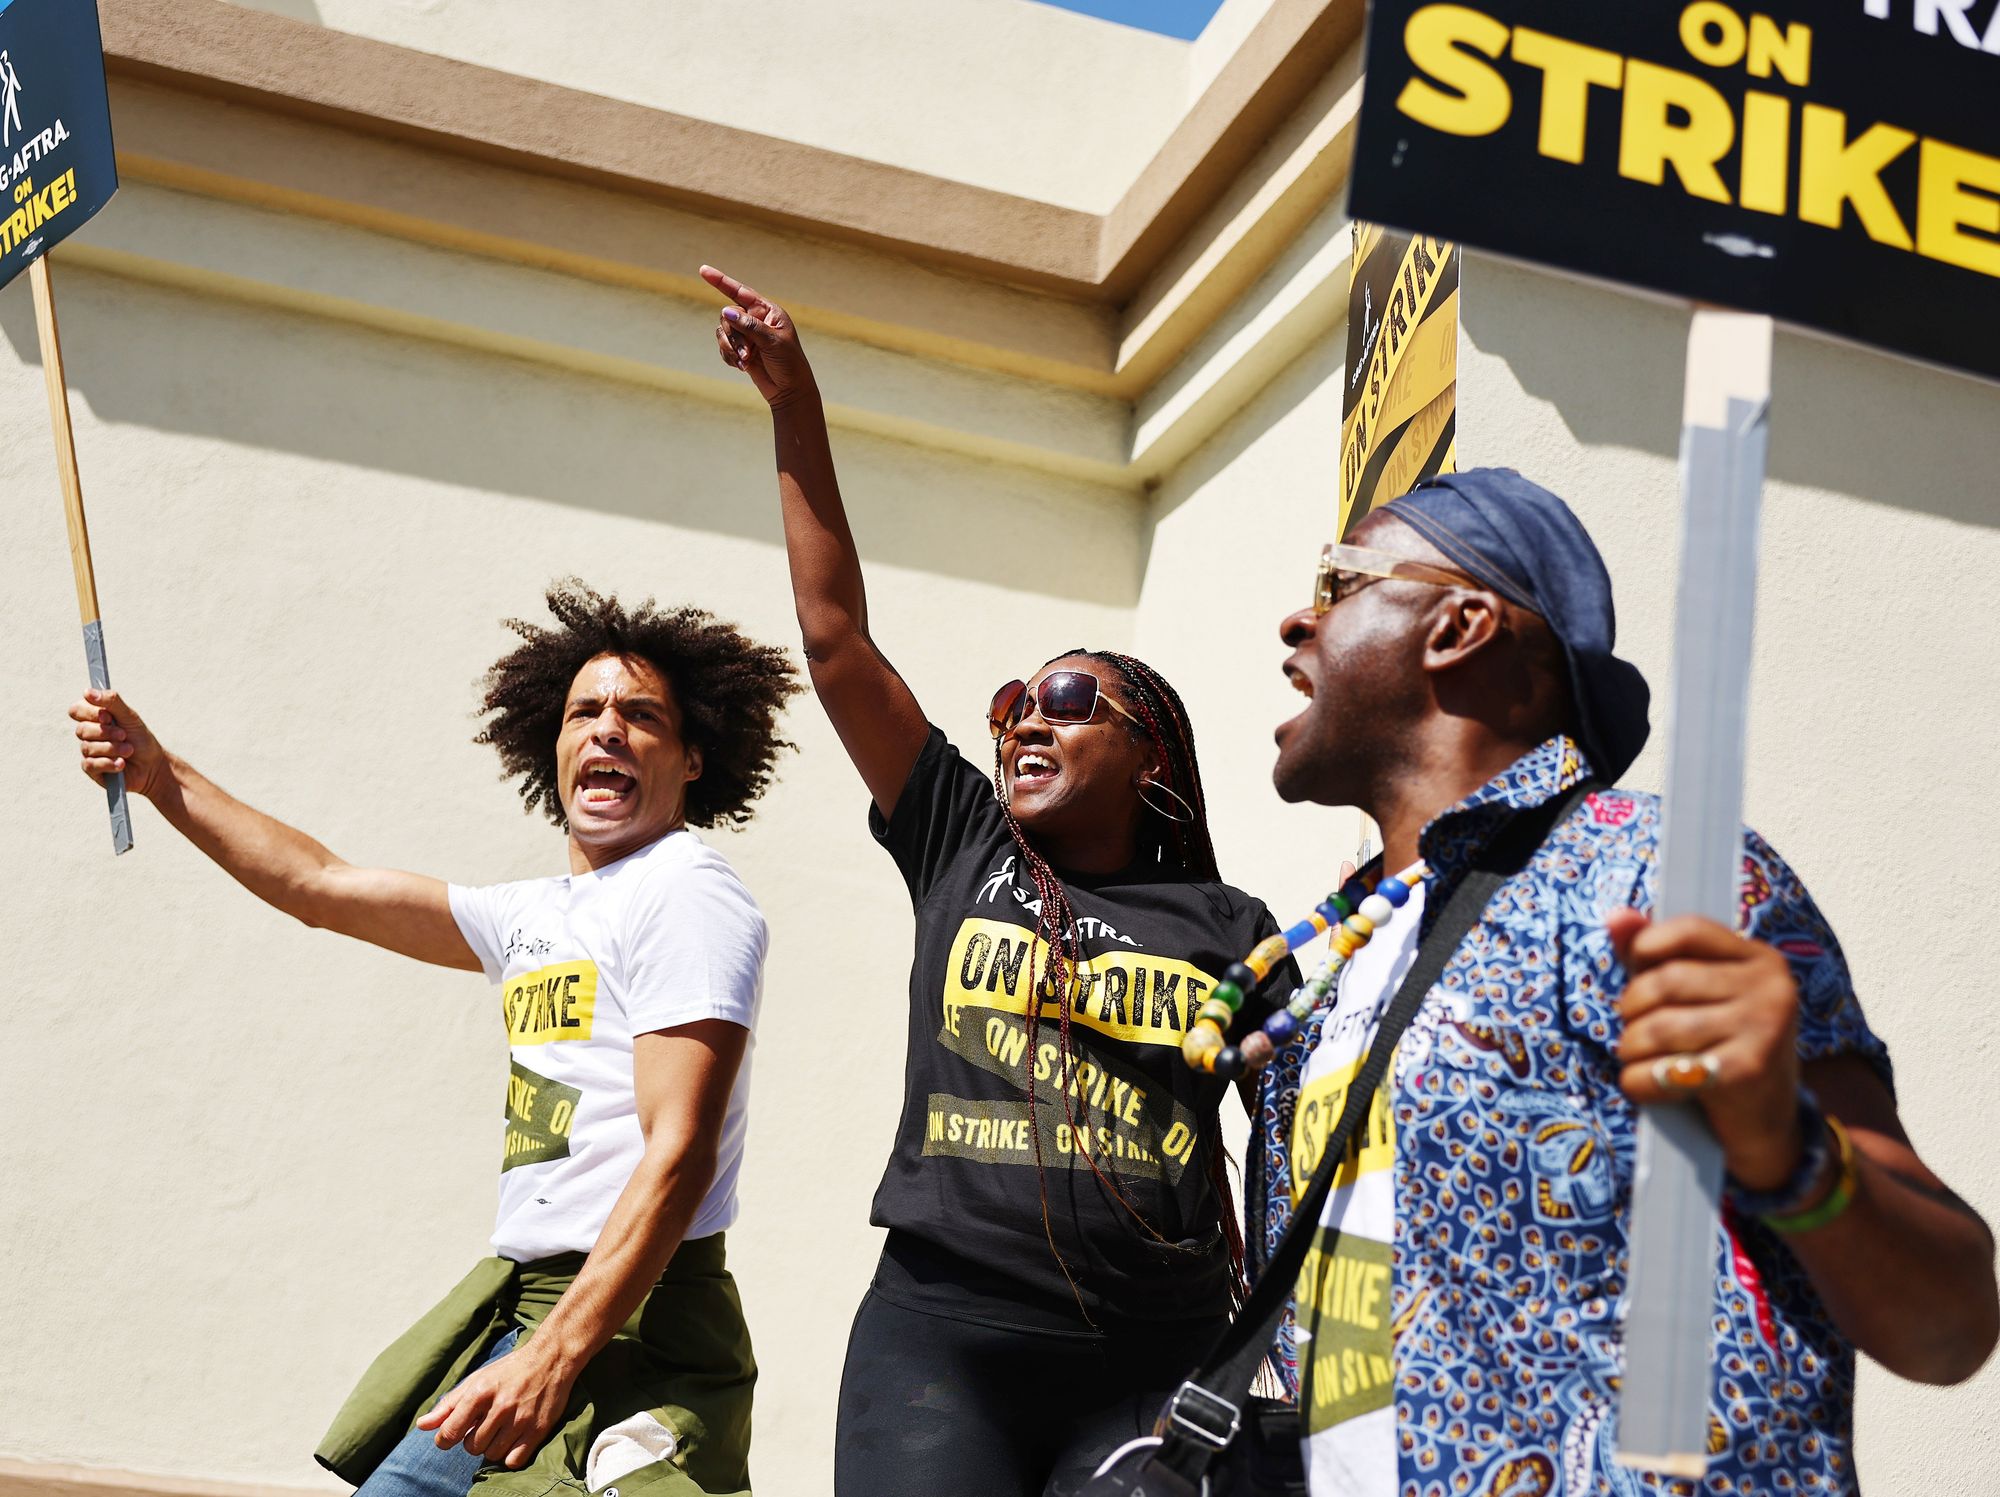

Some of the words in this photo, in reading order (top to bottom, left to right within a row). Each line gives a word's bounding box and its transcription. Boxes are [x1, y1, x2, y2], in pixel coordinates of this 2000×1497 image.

[1679, 2, 1812, 87] ON
[1396, 4, 2000, 279] STRIKE
[0, 167, 77, 259] TRIKE!
[14, 176, 33, 204] ON
[1346, 403, 1366, 503] ON
[960, 932, 1028, 996] ON
[986, 1016, 1027, 1068] ON
[1034, 1043, 1147, 1128] STRIKE
[929, 1111, 945, 1142] ON
[948, 1113, 1029, 1150] STRIKE
[1056, 1123, 1090, 1155] ON
[1297, 1248, 1388, 1331] STRIKE
[1313, 1353, 1341, 1408] ON
